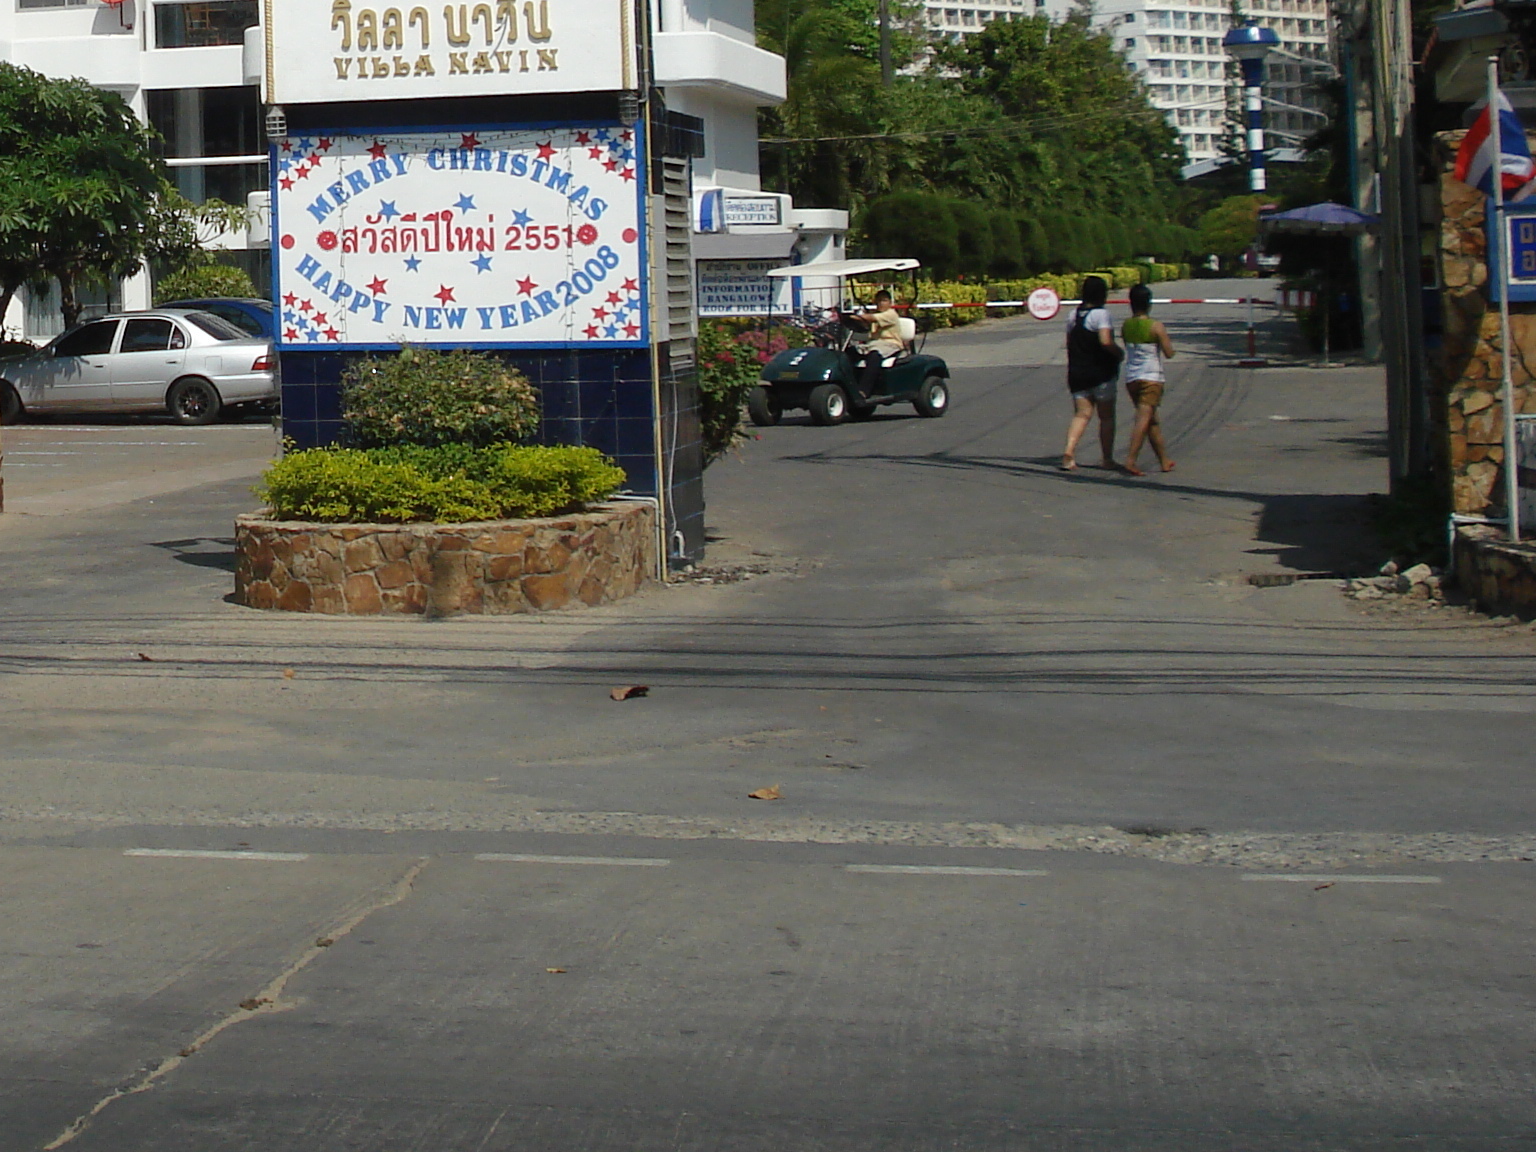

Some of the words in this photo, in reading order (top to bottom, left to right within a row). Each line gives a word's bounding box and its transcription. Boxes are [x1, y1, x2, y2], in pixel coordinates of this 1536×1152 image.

[334, 54, 435, 80] VILLA
[449, 48, 559, 75] NAVIN
[306, 152, 409, 225] MERRY
[427, 147, 609, 222] CHRISTMAS
[341, 209, 496, 255] สวัสดีปีใหม่
[505, 225, 574, 251] 2551
[295, 253, 392, 325] HAPPY
[403, 307, 468, 331] NEW
[707, 294, 773, 303] BANGALOW
